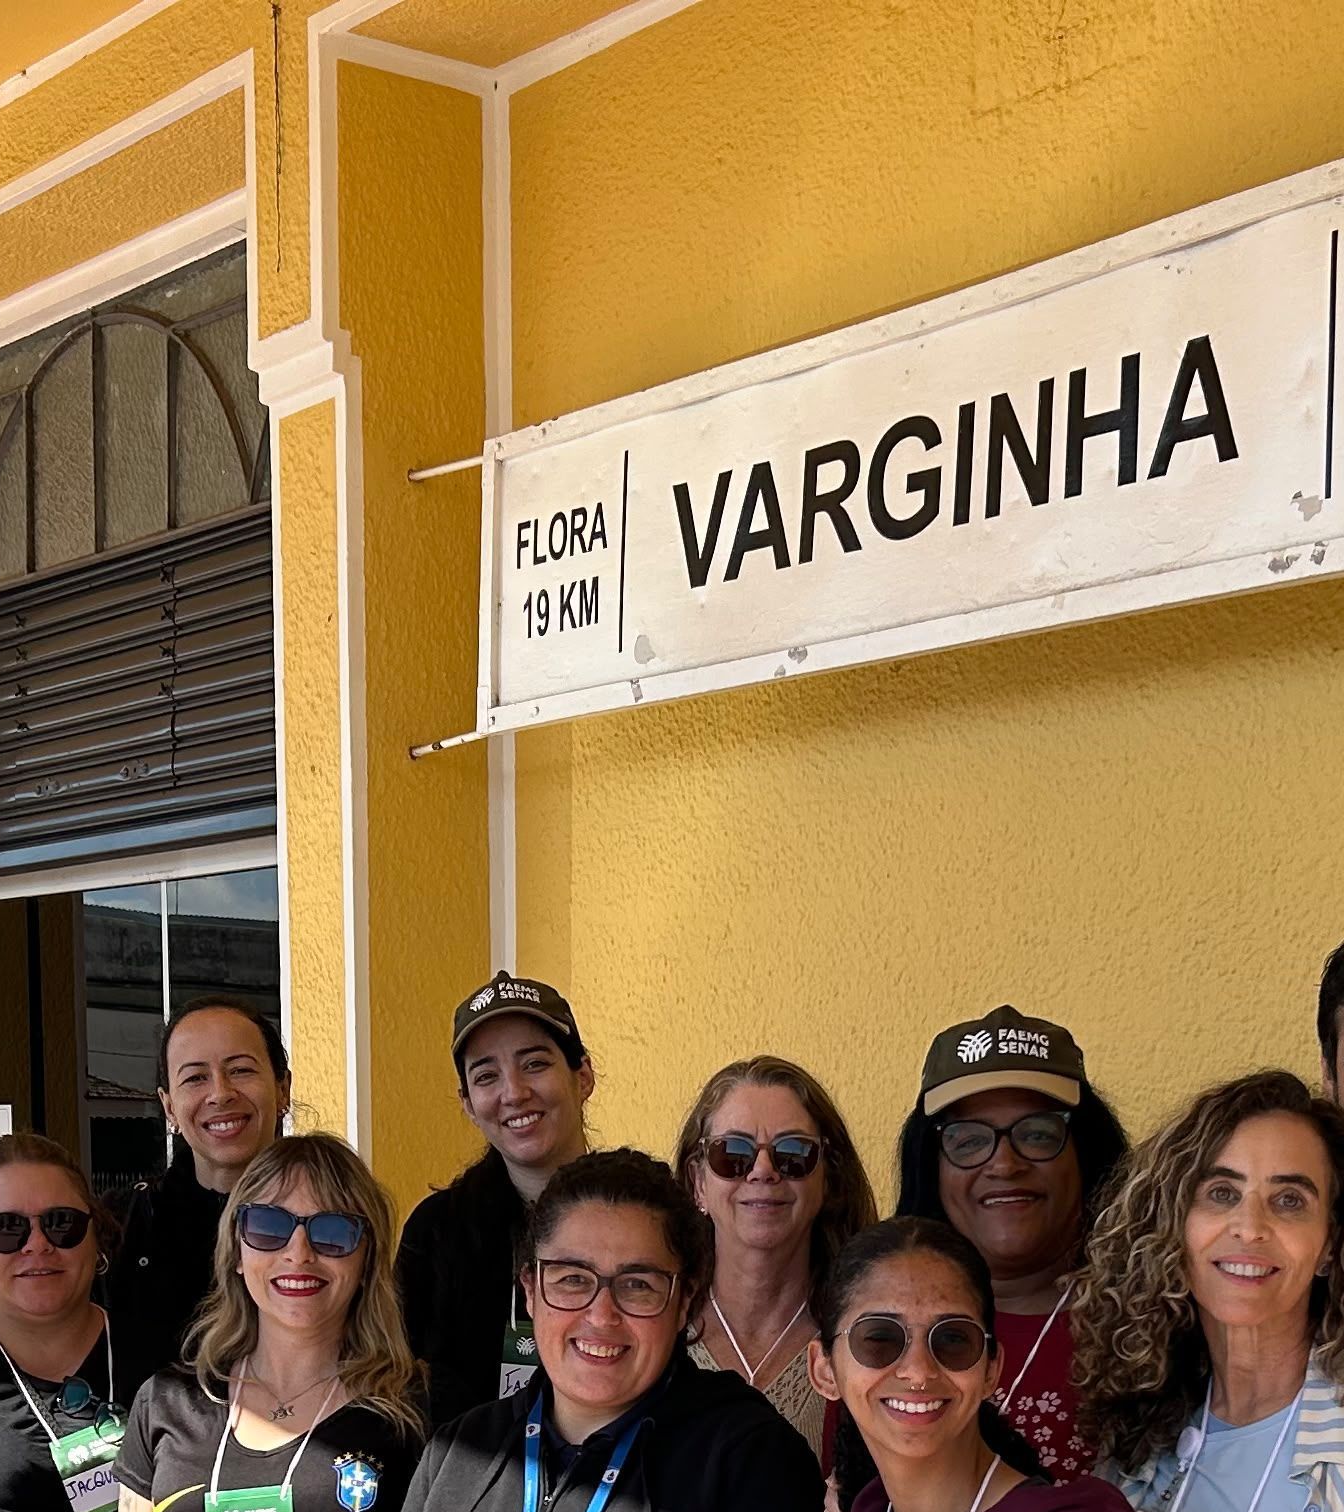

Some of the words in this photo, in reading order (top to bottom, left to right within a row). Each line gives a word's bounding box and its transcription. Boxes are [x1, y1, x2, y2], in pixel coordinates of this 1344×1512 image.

[671, 334, 1240, 590] VARGINHA
[515, 501, 608, 570] FLORA
[522, 588, 550, 640] 19
[559, 575, 600, 633] KM
[498, 982, 540, 998] FAEMG
[499, 990, 541, 1004] SENAR
[998, 1028, 1050, 1047] FAEMG
[998, 1042, 1049, 1060] SENAR
